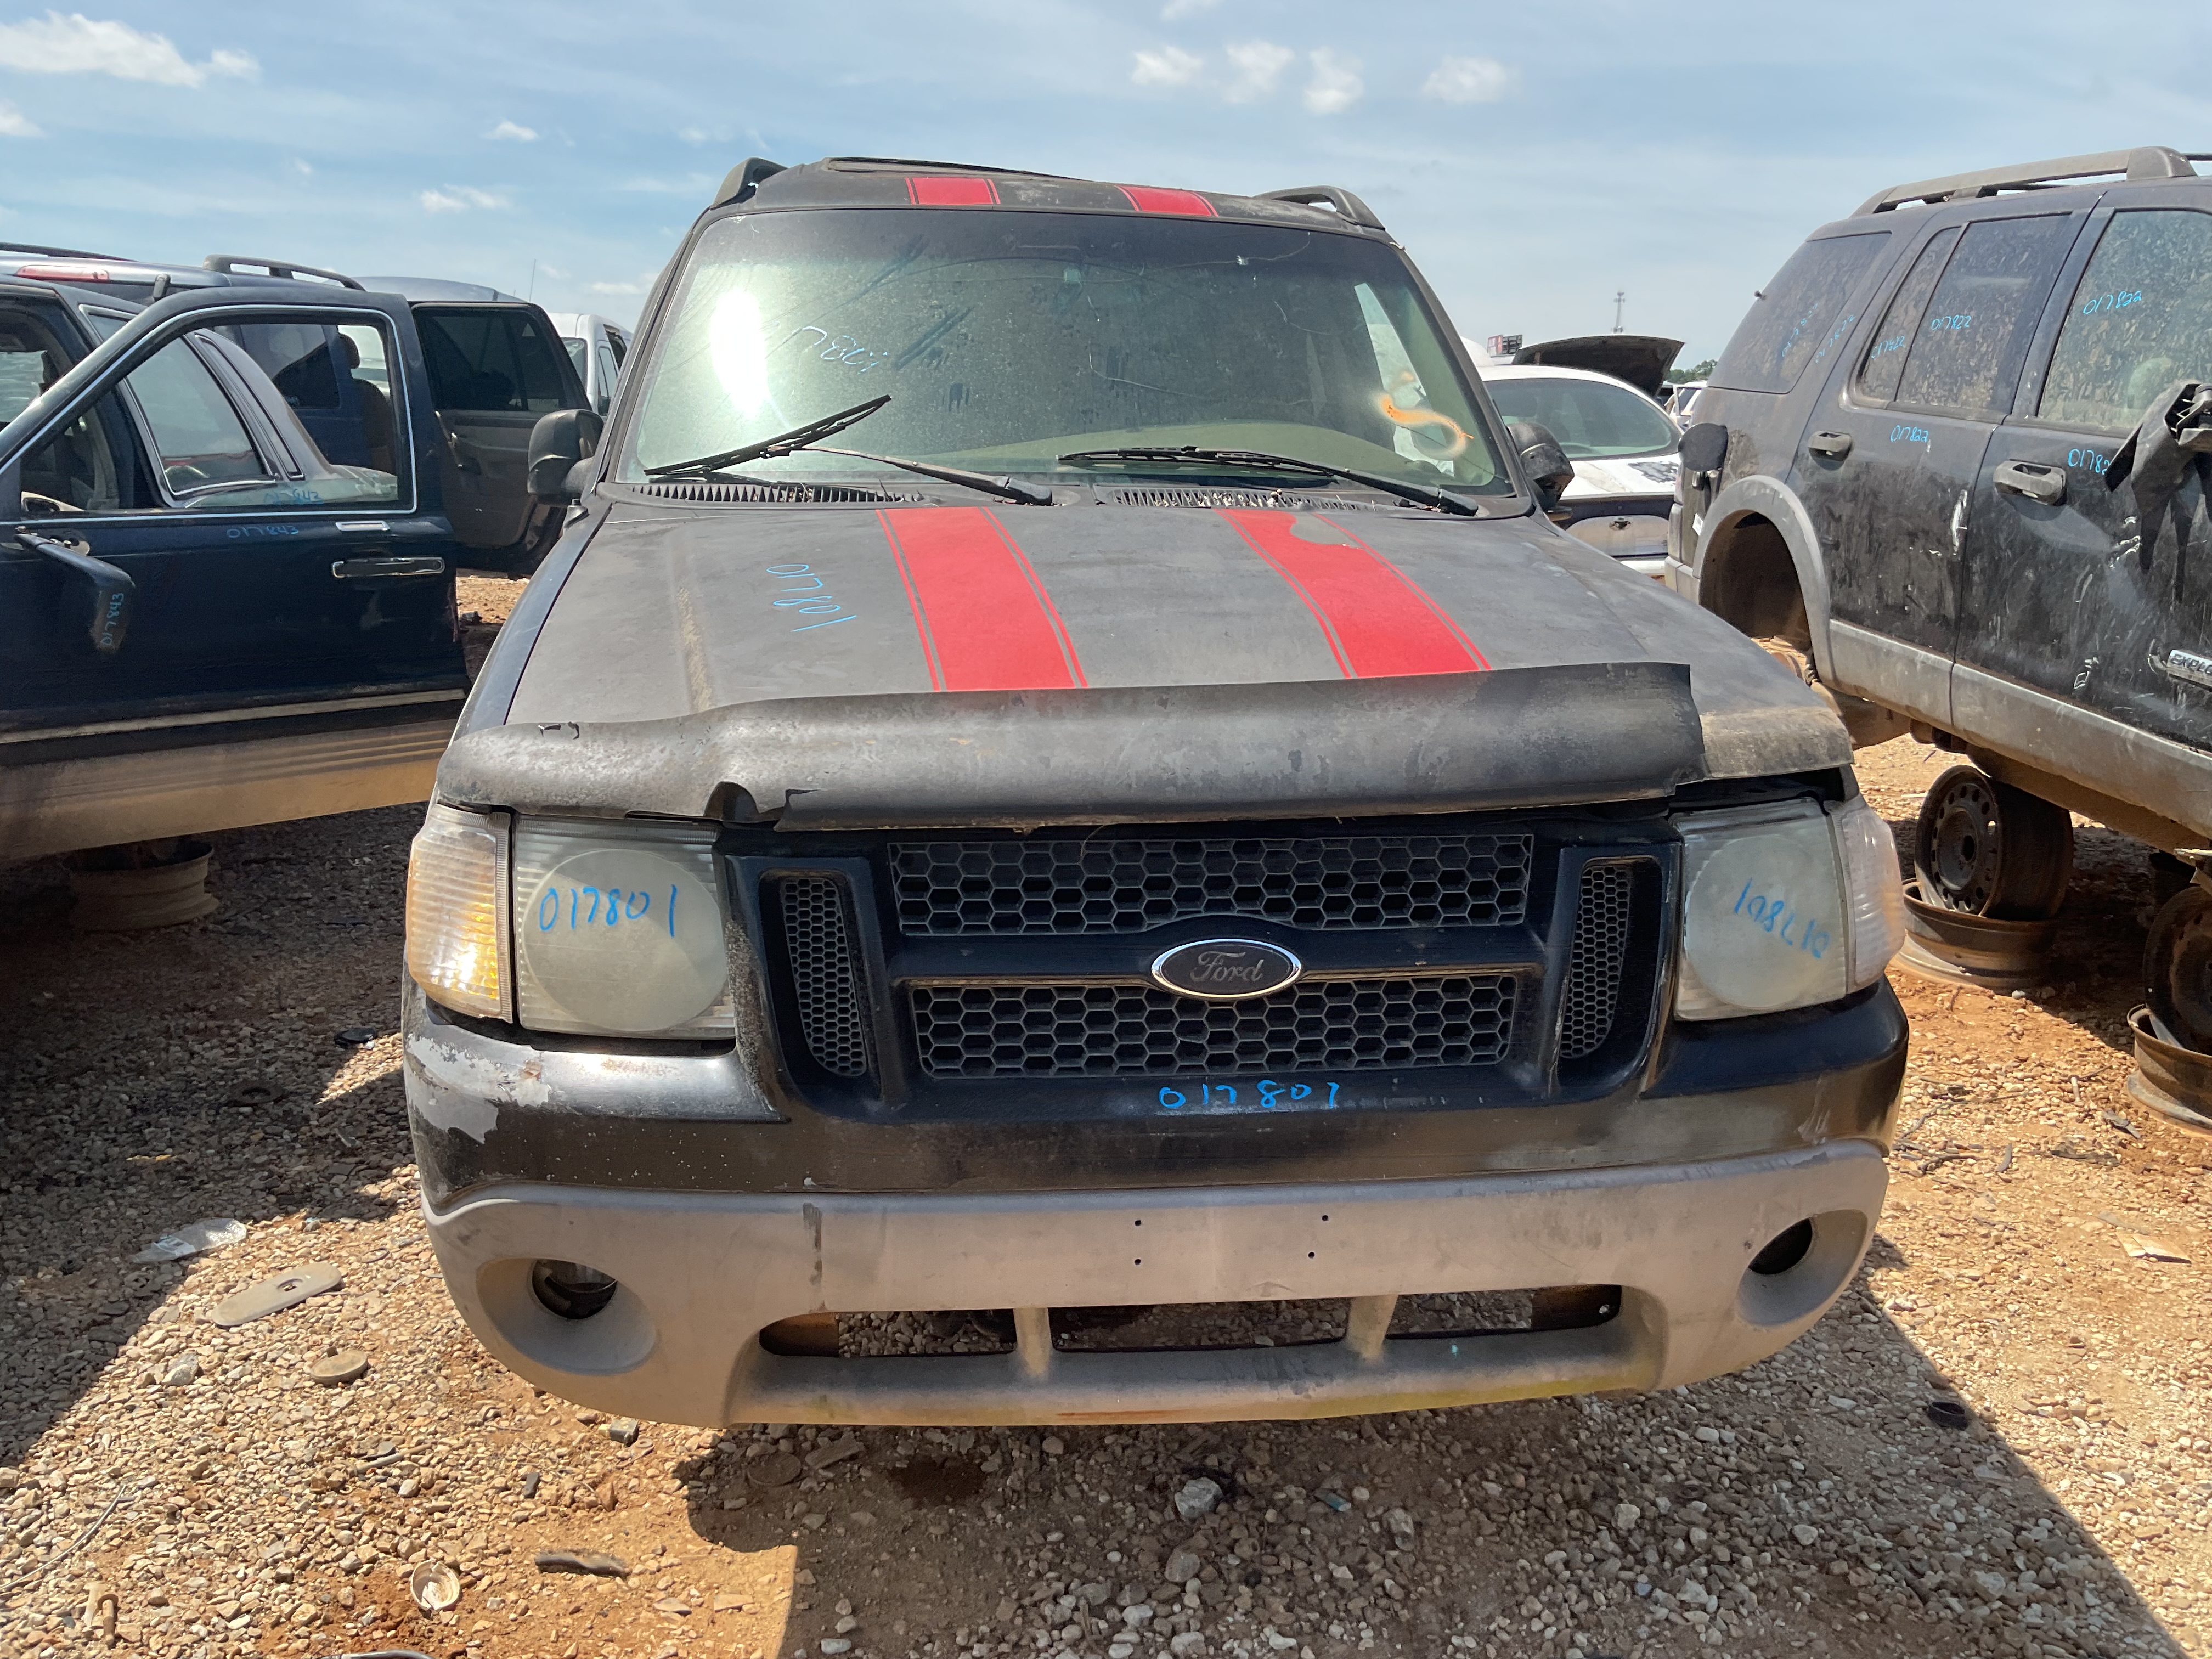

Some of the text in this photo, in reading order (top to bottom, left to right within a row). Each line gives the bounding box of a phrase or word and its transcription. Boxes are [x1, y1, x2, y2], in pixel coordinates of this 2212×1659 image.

[2083, 290, 2141, 314] 017822
[1931, 314, 1971, 330] 017822
[1871, 335, 1906, 358] 017822
[1890, 425, 1929, 443] 017822
[2068, 448, 2111, 476] 01782
[226, 525, 299, 538] 017843
[766, 563, 857, 632] 017801
[101, 593, 124, 645] 017843
[539, 884, 678, 938] 017801
[1190, 951, 1265, 982] Ford
